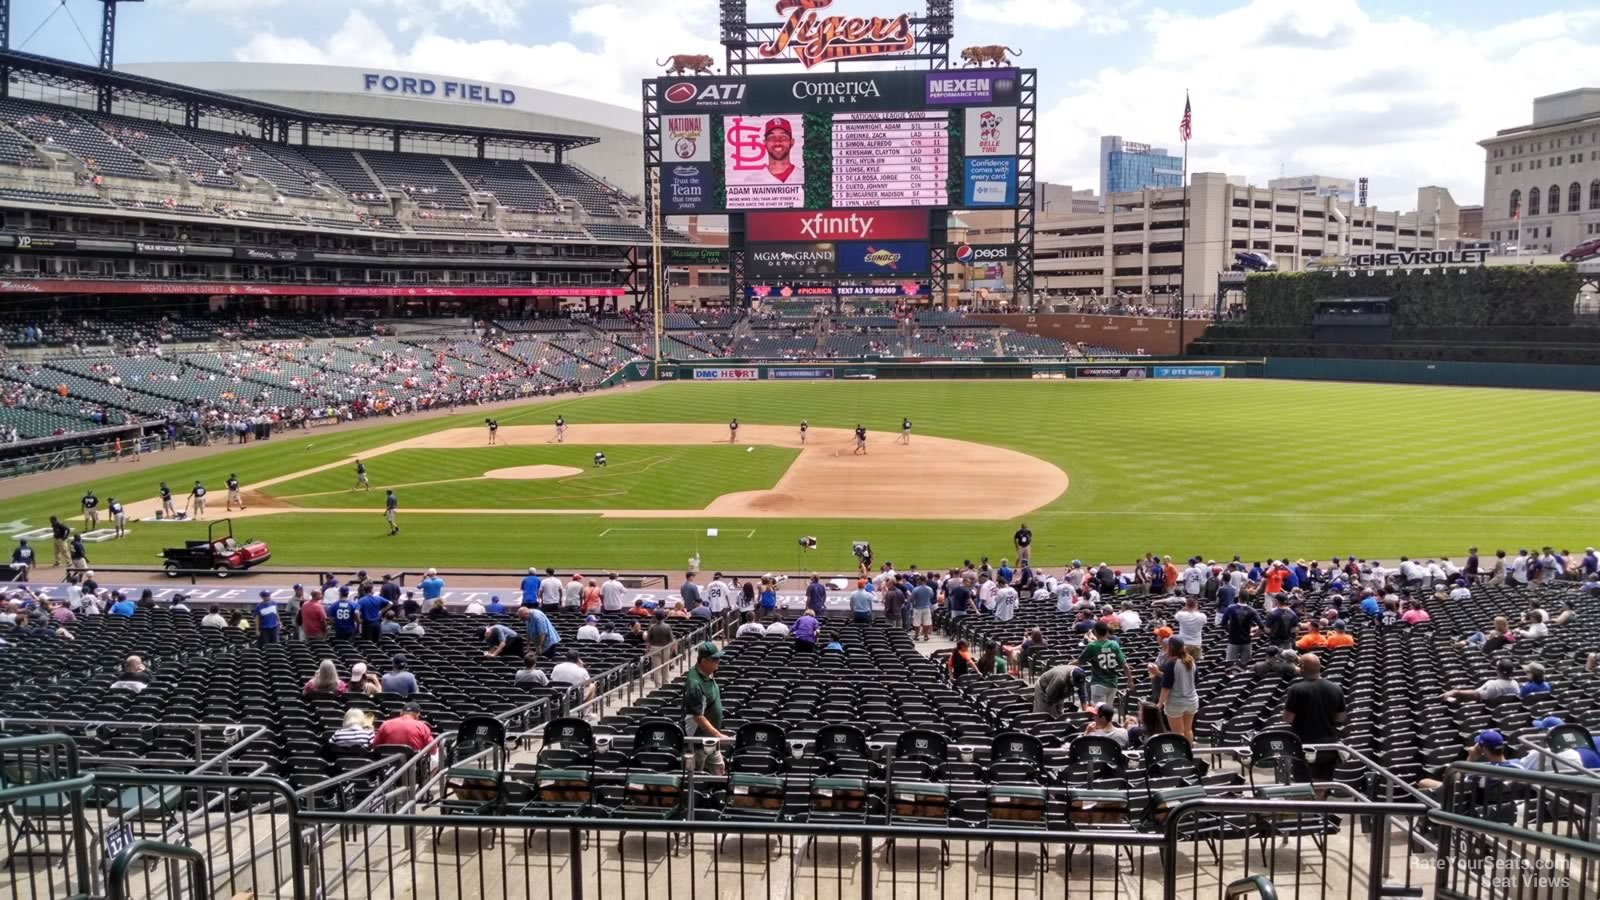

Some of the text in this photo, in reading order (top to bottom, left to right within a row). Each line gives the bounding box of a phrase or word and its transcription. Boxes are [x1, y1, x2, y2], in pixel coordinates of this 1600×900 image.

[759, 0, 909, 58] Tigers
[363, 73, 516, 104] FORD FIELD
[930, 78, 990, 93] NEXEN
[698, 84, 746, 100] ATI
[668, 118, 701, 131] NATIONAL
[671, 184, 701, 195] Team
[800, 213, 874, 238] xfinity
[700, 249, 720, 258] Green
[754, 251, 832, 261] MGM GRAND
[974, 247, 1007, 259] pepsi
[1356, 250, 1490, 266] CHEVROLET
[1332, 268, 1468, 277] FOUNTAIN
[1188, 368, 1215, 376] Energy
[154, 588, 247, 599] THE
[711, 589, 721, 597] 24
[337, 609, 350, 620] 66
[1097, 653, 1117, 669] 26
